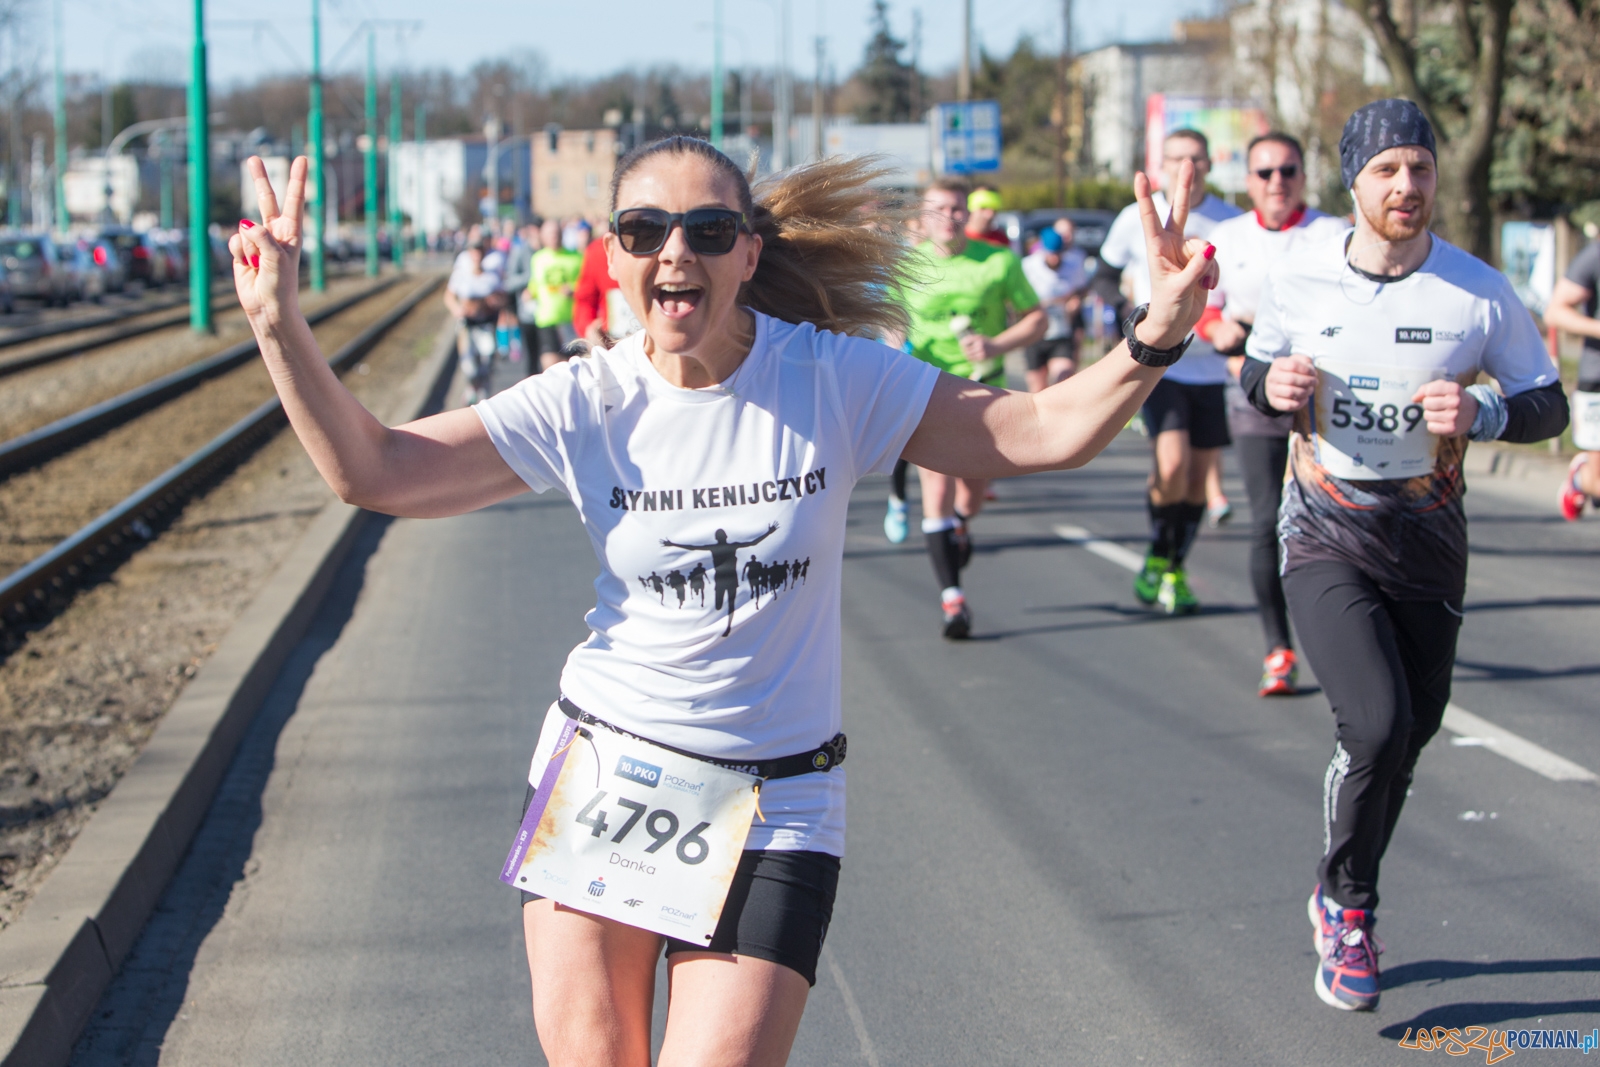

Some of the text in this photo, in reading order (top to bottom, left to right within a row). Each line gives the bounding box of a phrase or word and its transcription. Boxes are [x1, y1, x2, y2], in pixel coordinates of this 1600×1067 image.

[1320, 326, 1342, 337] 4F
[1331, 398, 1424, 433] 5389
[609, 467, 826, 511] SŁYNNI KENIJCZYCY
[575, 790, 711, 865] 4796
[609, 852, 656, 875] Danka
